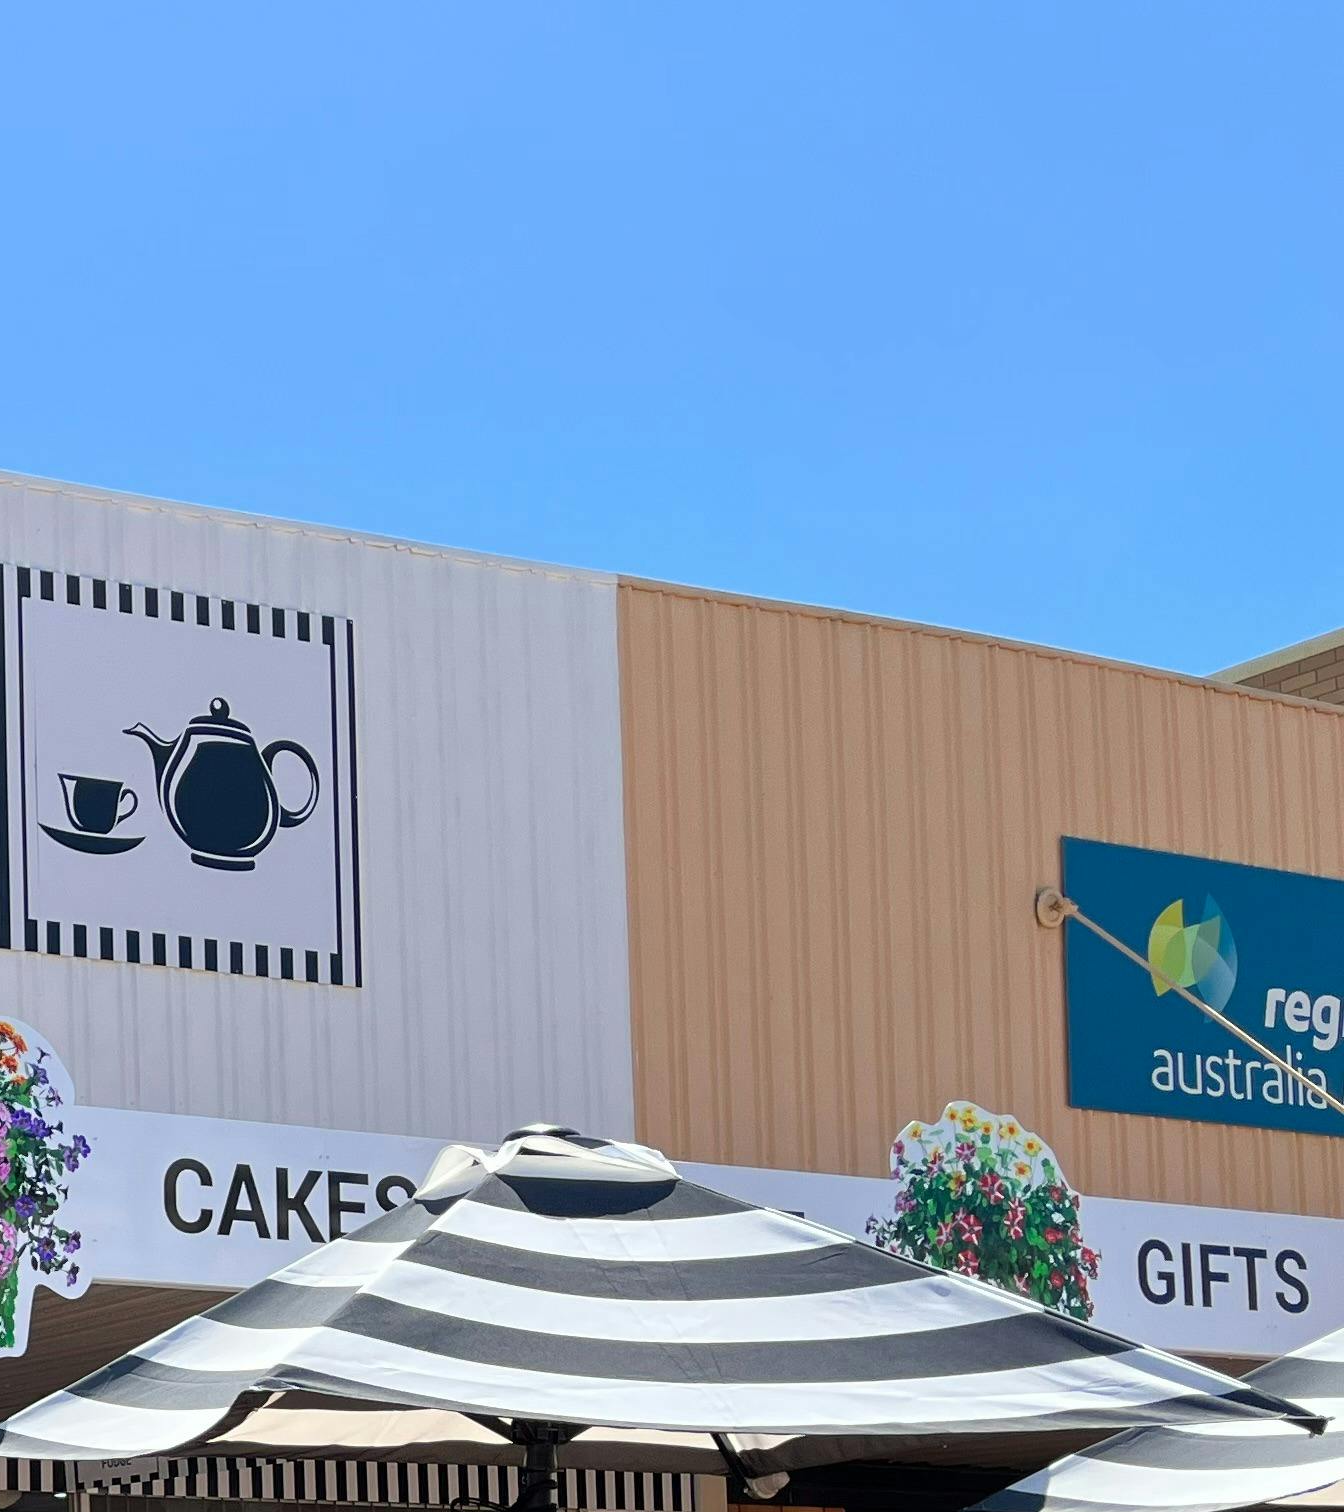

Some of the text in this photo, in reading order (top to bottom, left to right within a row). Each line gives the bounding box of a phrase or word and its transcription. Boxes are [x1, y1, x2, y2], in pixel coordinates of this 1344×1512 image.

[1265, 987, 1344, 1050] reg
[1151, 1044, 1328, 1110] australia
[1138, 1238, 1310, 1314] GIFTS
